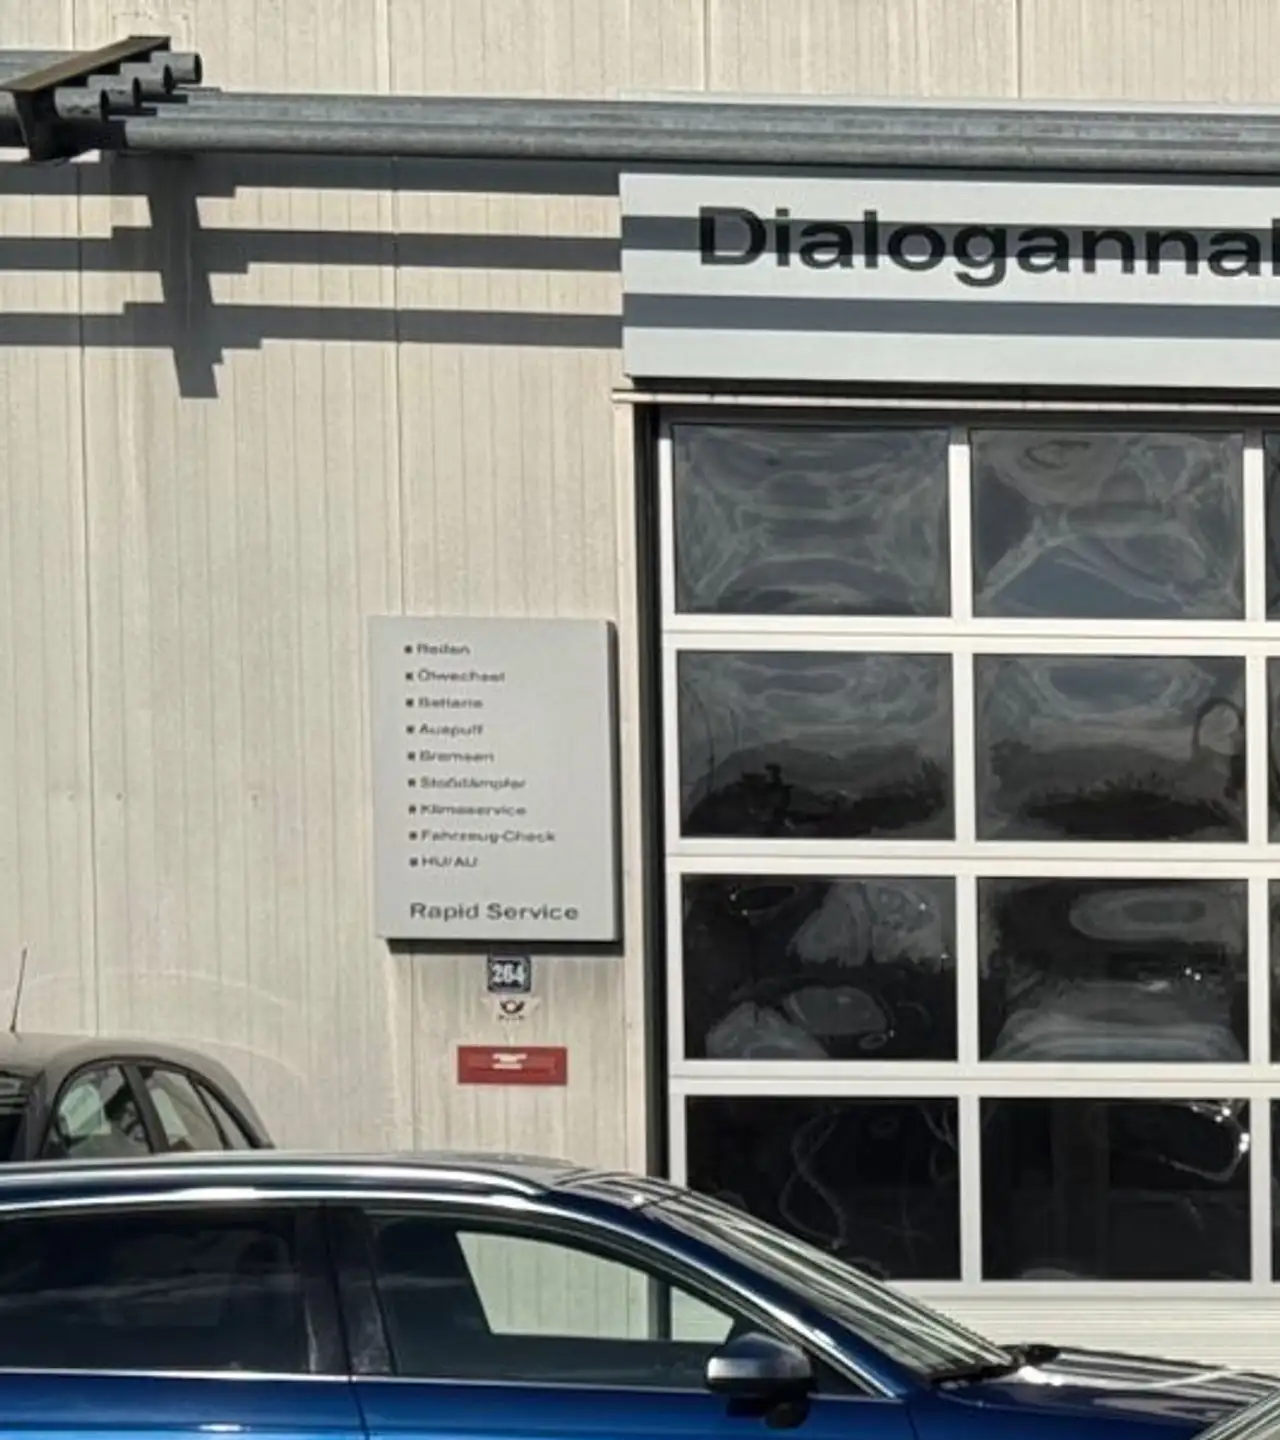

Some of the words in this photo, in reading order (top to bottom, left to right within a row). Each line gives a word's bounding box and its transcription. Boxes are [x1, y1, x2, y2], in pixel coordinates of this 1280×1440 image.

[416, 643, 471, 655] Reifen
[418, 723, 483, 738] Auspuff
[419, 750, 495, 763] Bremsen
[420, 803, 528, 816] Klimaservice
[409, 902, 480, 922] Rapid
[486, 902, 580, 921] Service
